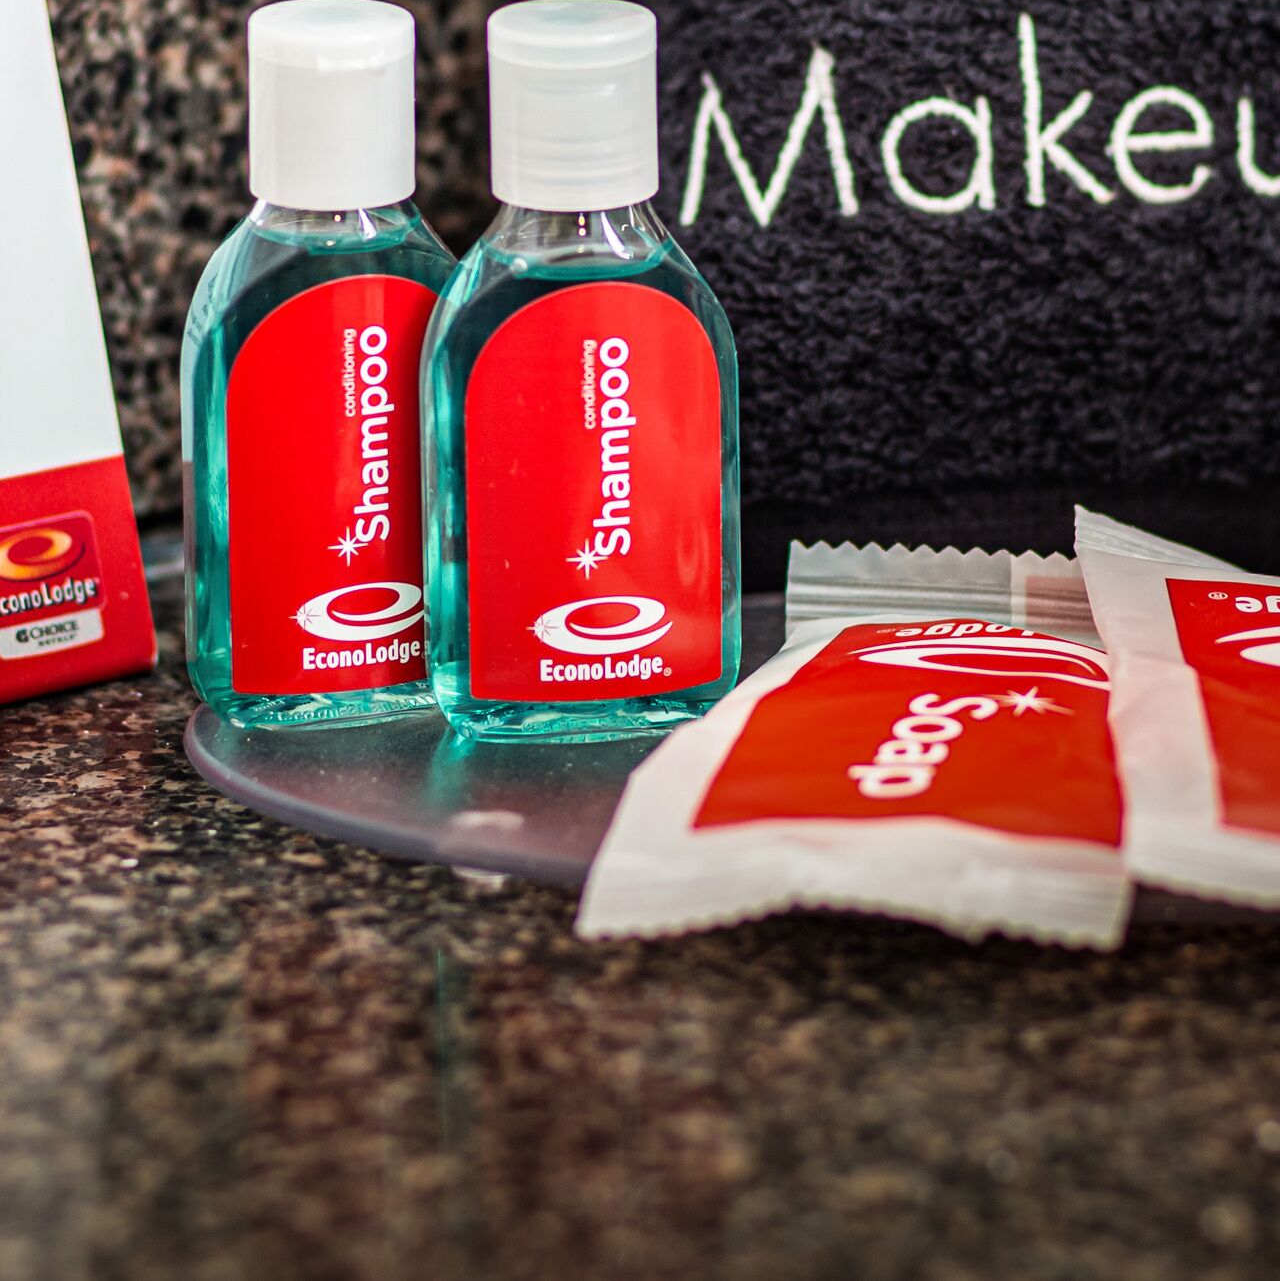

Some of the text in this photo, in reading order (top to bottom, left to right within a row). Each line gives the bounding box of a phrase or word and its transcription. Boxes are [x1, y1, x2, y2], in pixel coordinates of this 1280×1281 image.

[343, 327, 357, 417] conditioning
[581, 339, 597, 430] conditioning
[353, 325, 394, 542] Shampoo
[593, 337, 636, 556] Shampoo
[847, 693, 999, 799] Soap
